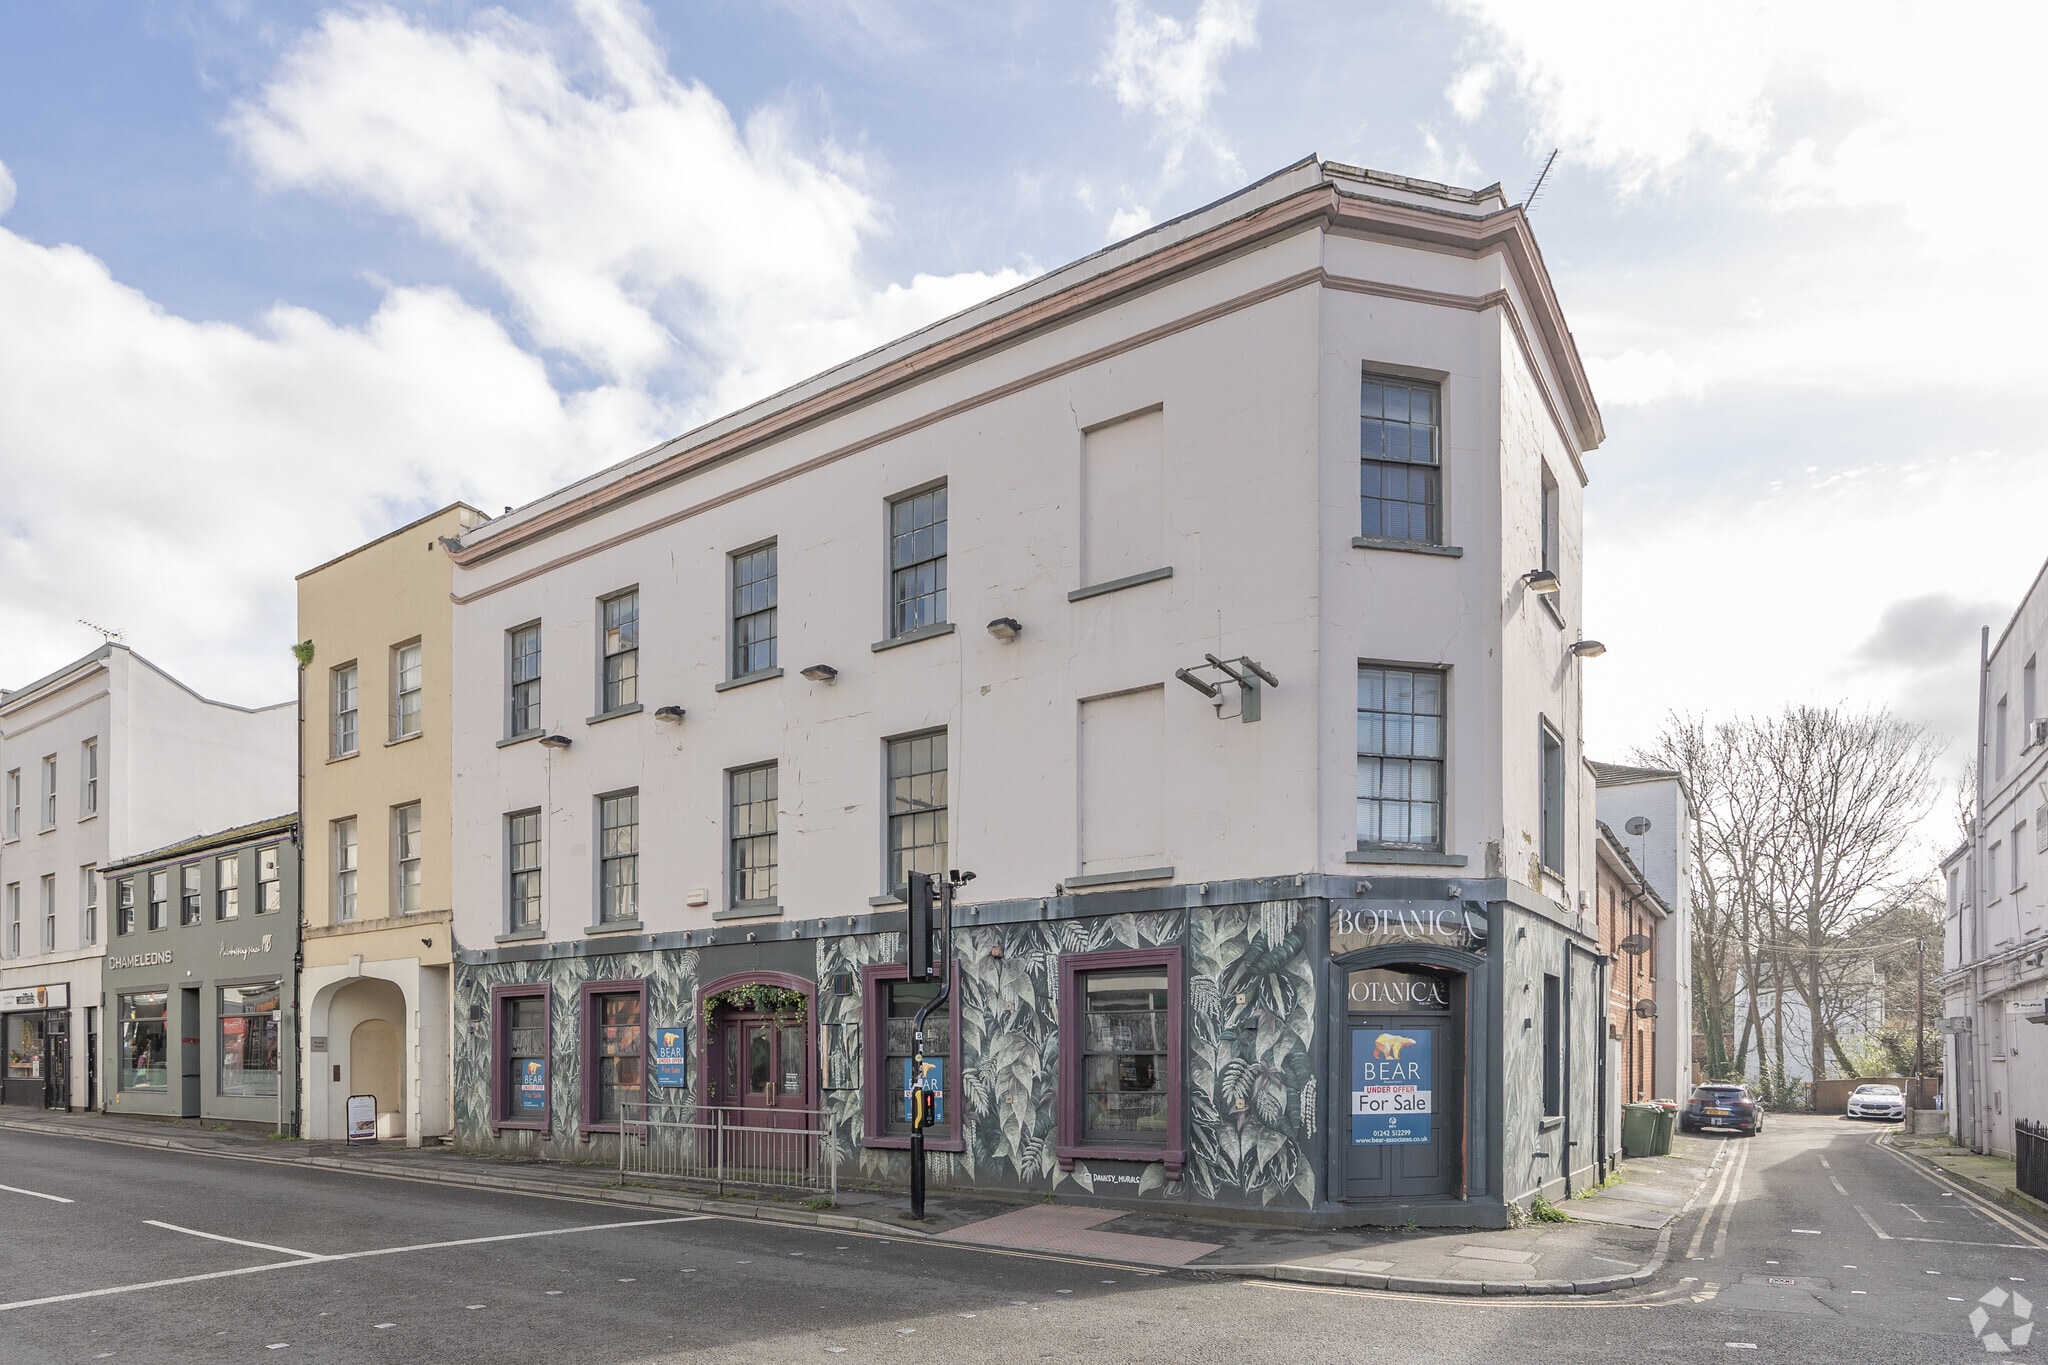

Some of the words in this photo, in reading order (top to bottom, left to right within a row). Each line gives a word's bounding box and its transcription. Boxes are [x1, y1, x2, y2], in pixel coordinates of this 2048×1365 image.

[1337, 908, 1487, 939] BOTANICA
[108, 950, 173, 970] CHAMELEONS
[1348, 981, 1449, 1005] OTANICA
[660, 1047, 681, 1058] BEAR
[524, 1074, 543, 1084] BEAR
[1364, 1061, 1421, 1081] BEAR
[1366, 1086, 1391, 1094] UNDER
[1392, 1085, 1415, 1093] OFFER
[1359, 1094, 1389, 1112] For
[1394, 1094, 1426, 1111] Sale
